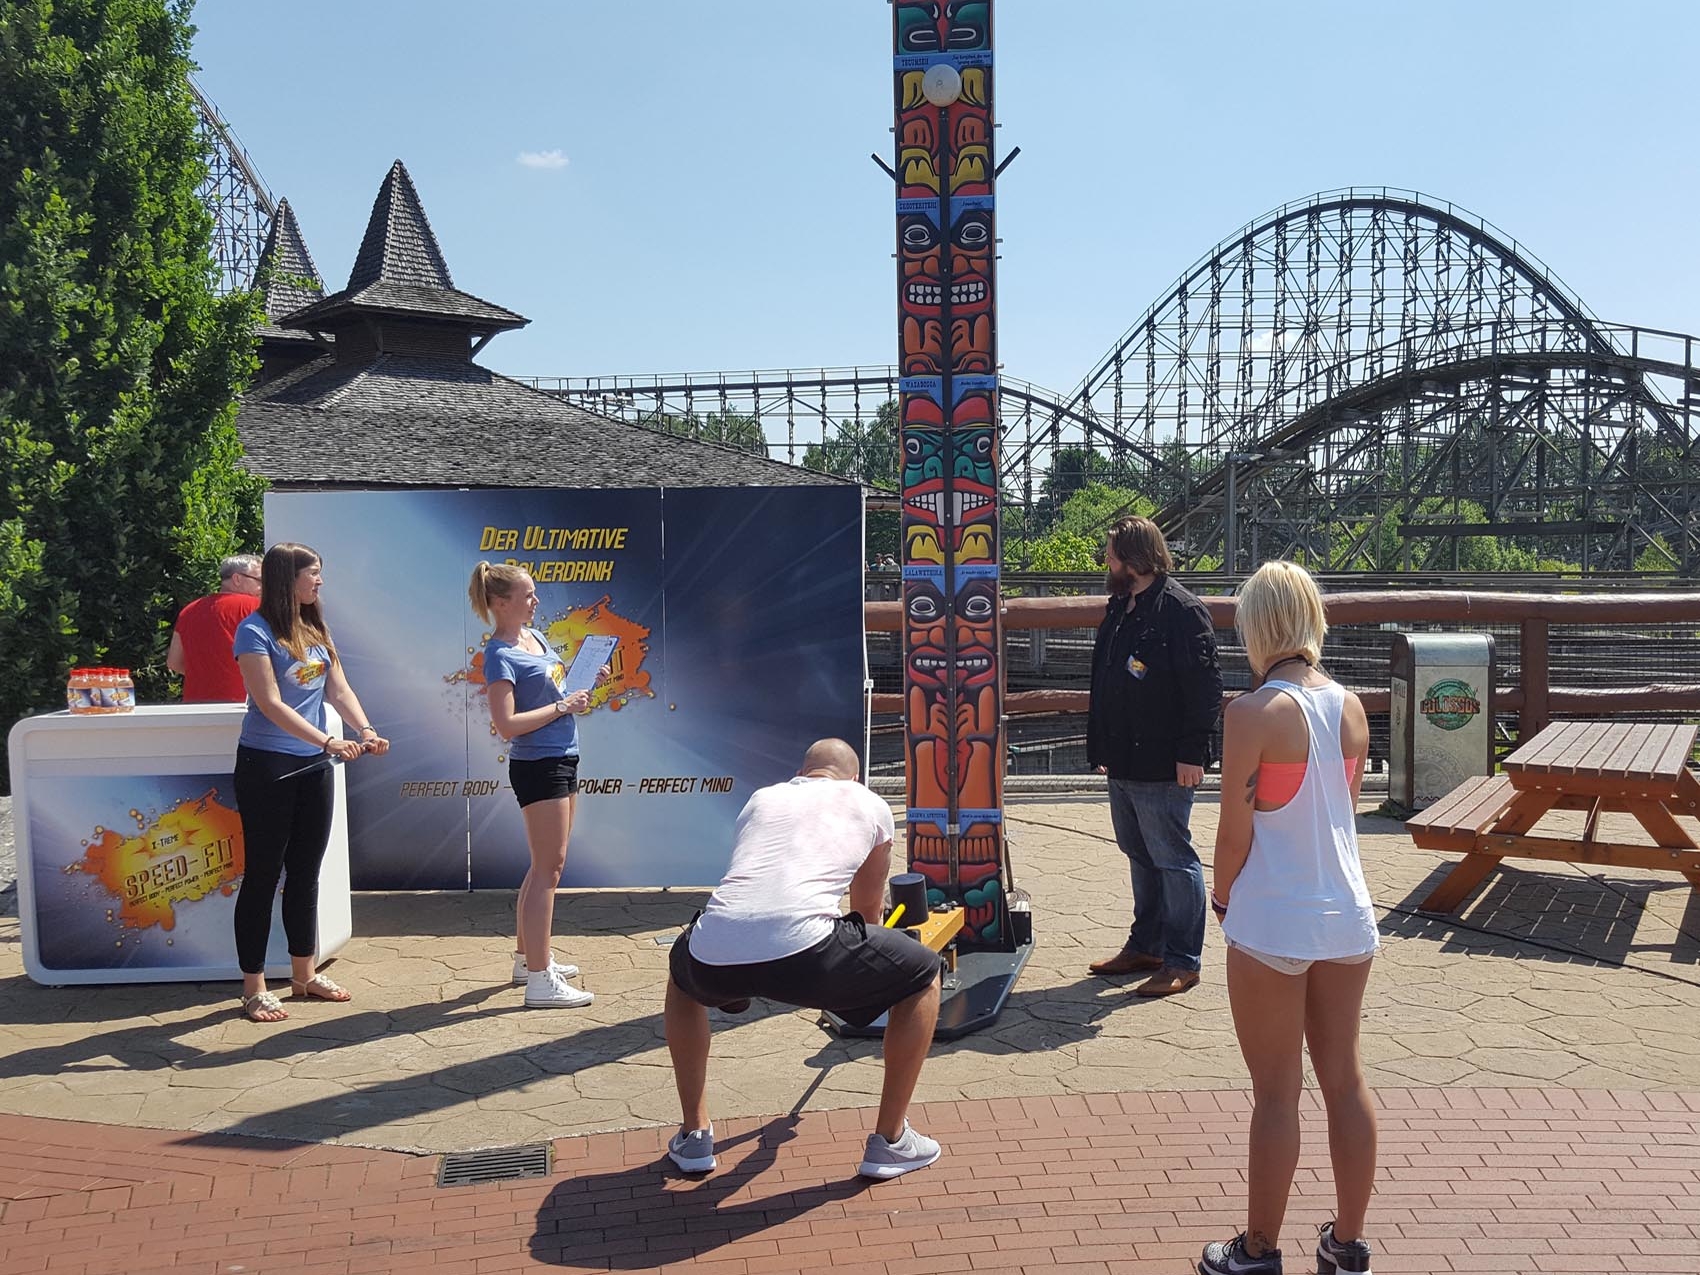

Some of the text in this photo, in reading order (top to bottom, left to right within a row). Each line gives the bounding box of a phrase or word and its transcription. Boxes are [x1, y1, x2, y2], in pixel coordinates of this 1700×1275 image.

[479, 525, 629, 551] DER ULTIMATIVE
[1420, 695, 1480, 713] COLOSSOS
[400, 780, 460, 798] PERFECT
[462, 780, 500, 796] BODY
[577, 778, 623, 795] POWER
[638, 777, 698, 794] PERFECT
[699, 776, 734, 793] MIND
